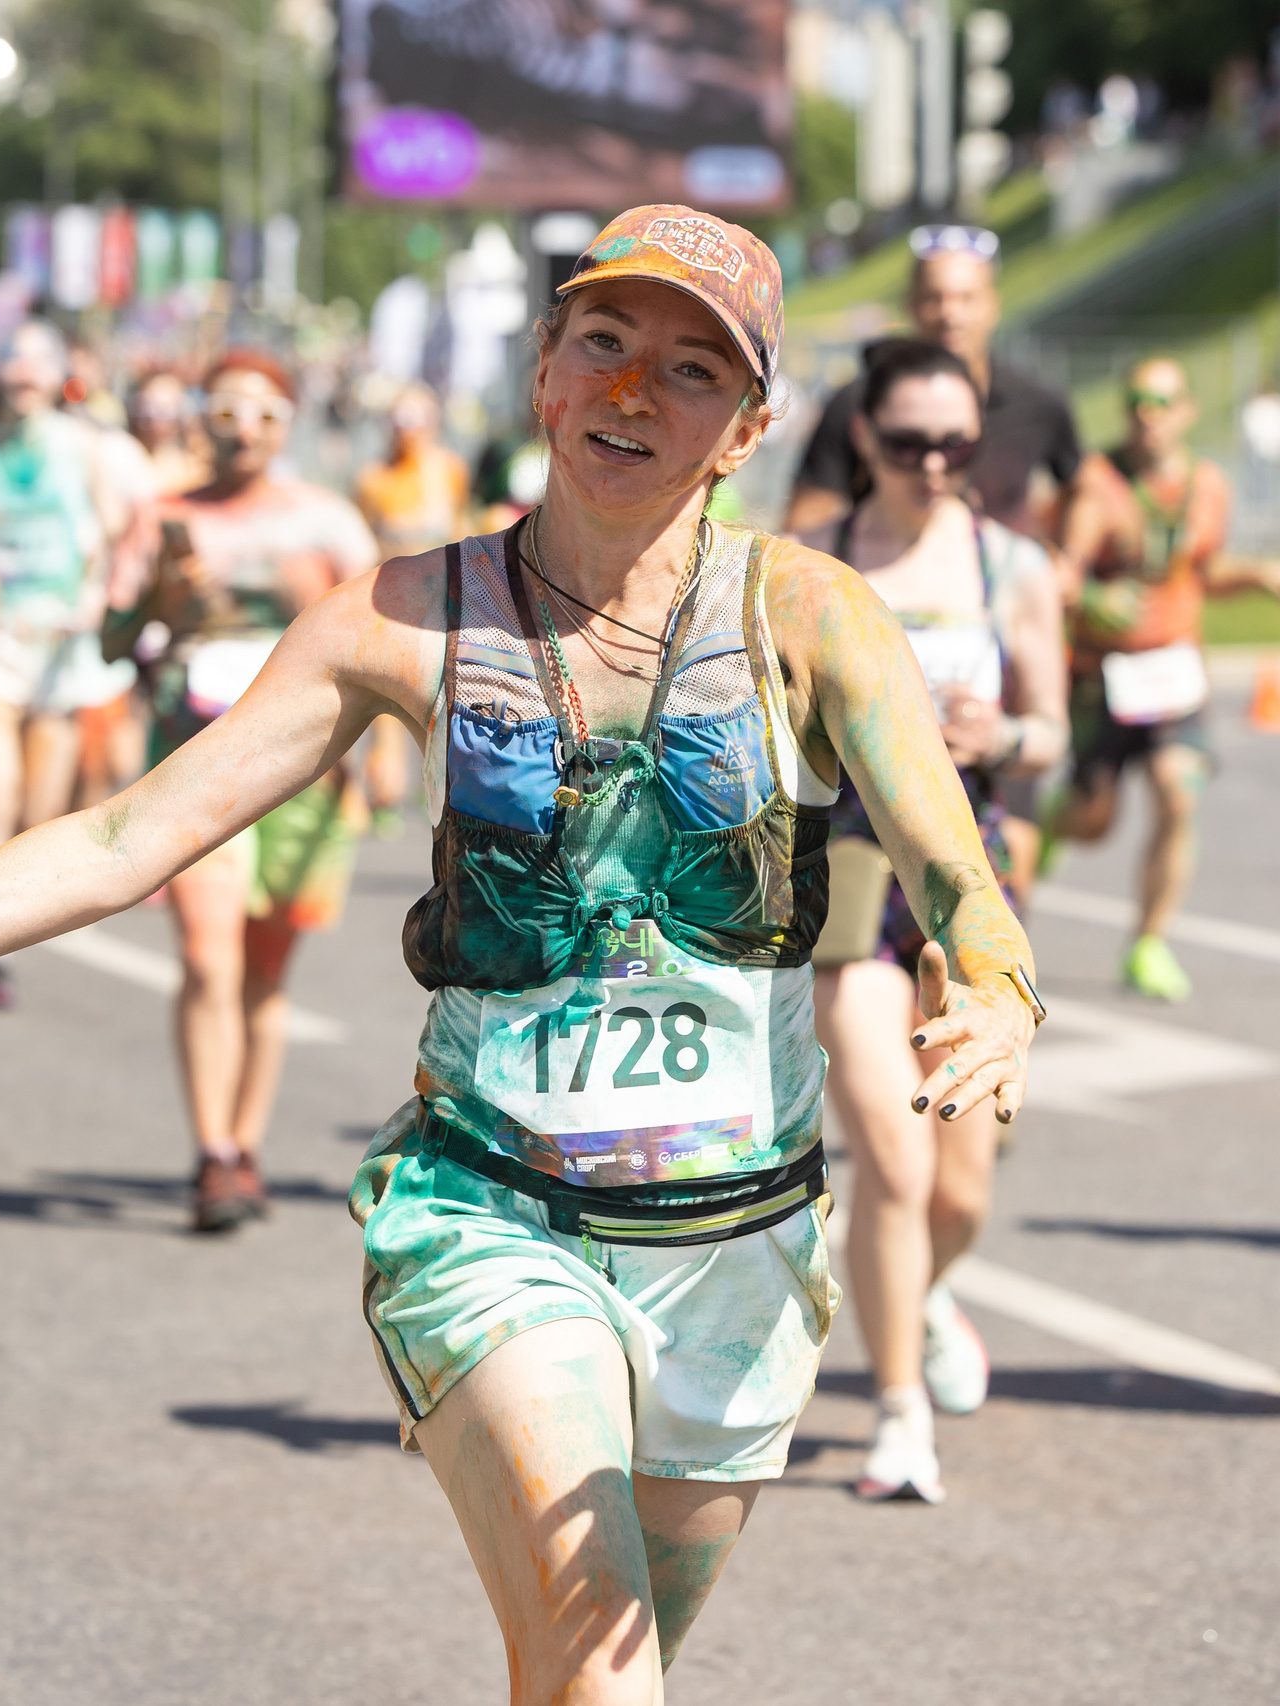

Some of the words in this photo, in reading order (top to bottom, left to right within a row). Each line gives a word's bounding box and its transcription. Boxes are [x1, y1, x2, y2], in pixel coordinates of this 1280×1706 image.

[654, 221, 667, 230] 19
[667, 227, 698, 242] NEW
[699, 239, 724, 259] ERA
[675, 239, 696, 250] CAP
[723, 259, 737, 274] 20
[520, 1002, 710, 1094] 1728
[576, 1152, 617, 1166] МОСКОВСКИЙ
[673, 1150, 700, 1162] СБЕР
[576, 1163, 597, 1173] СПОРТ
